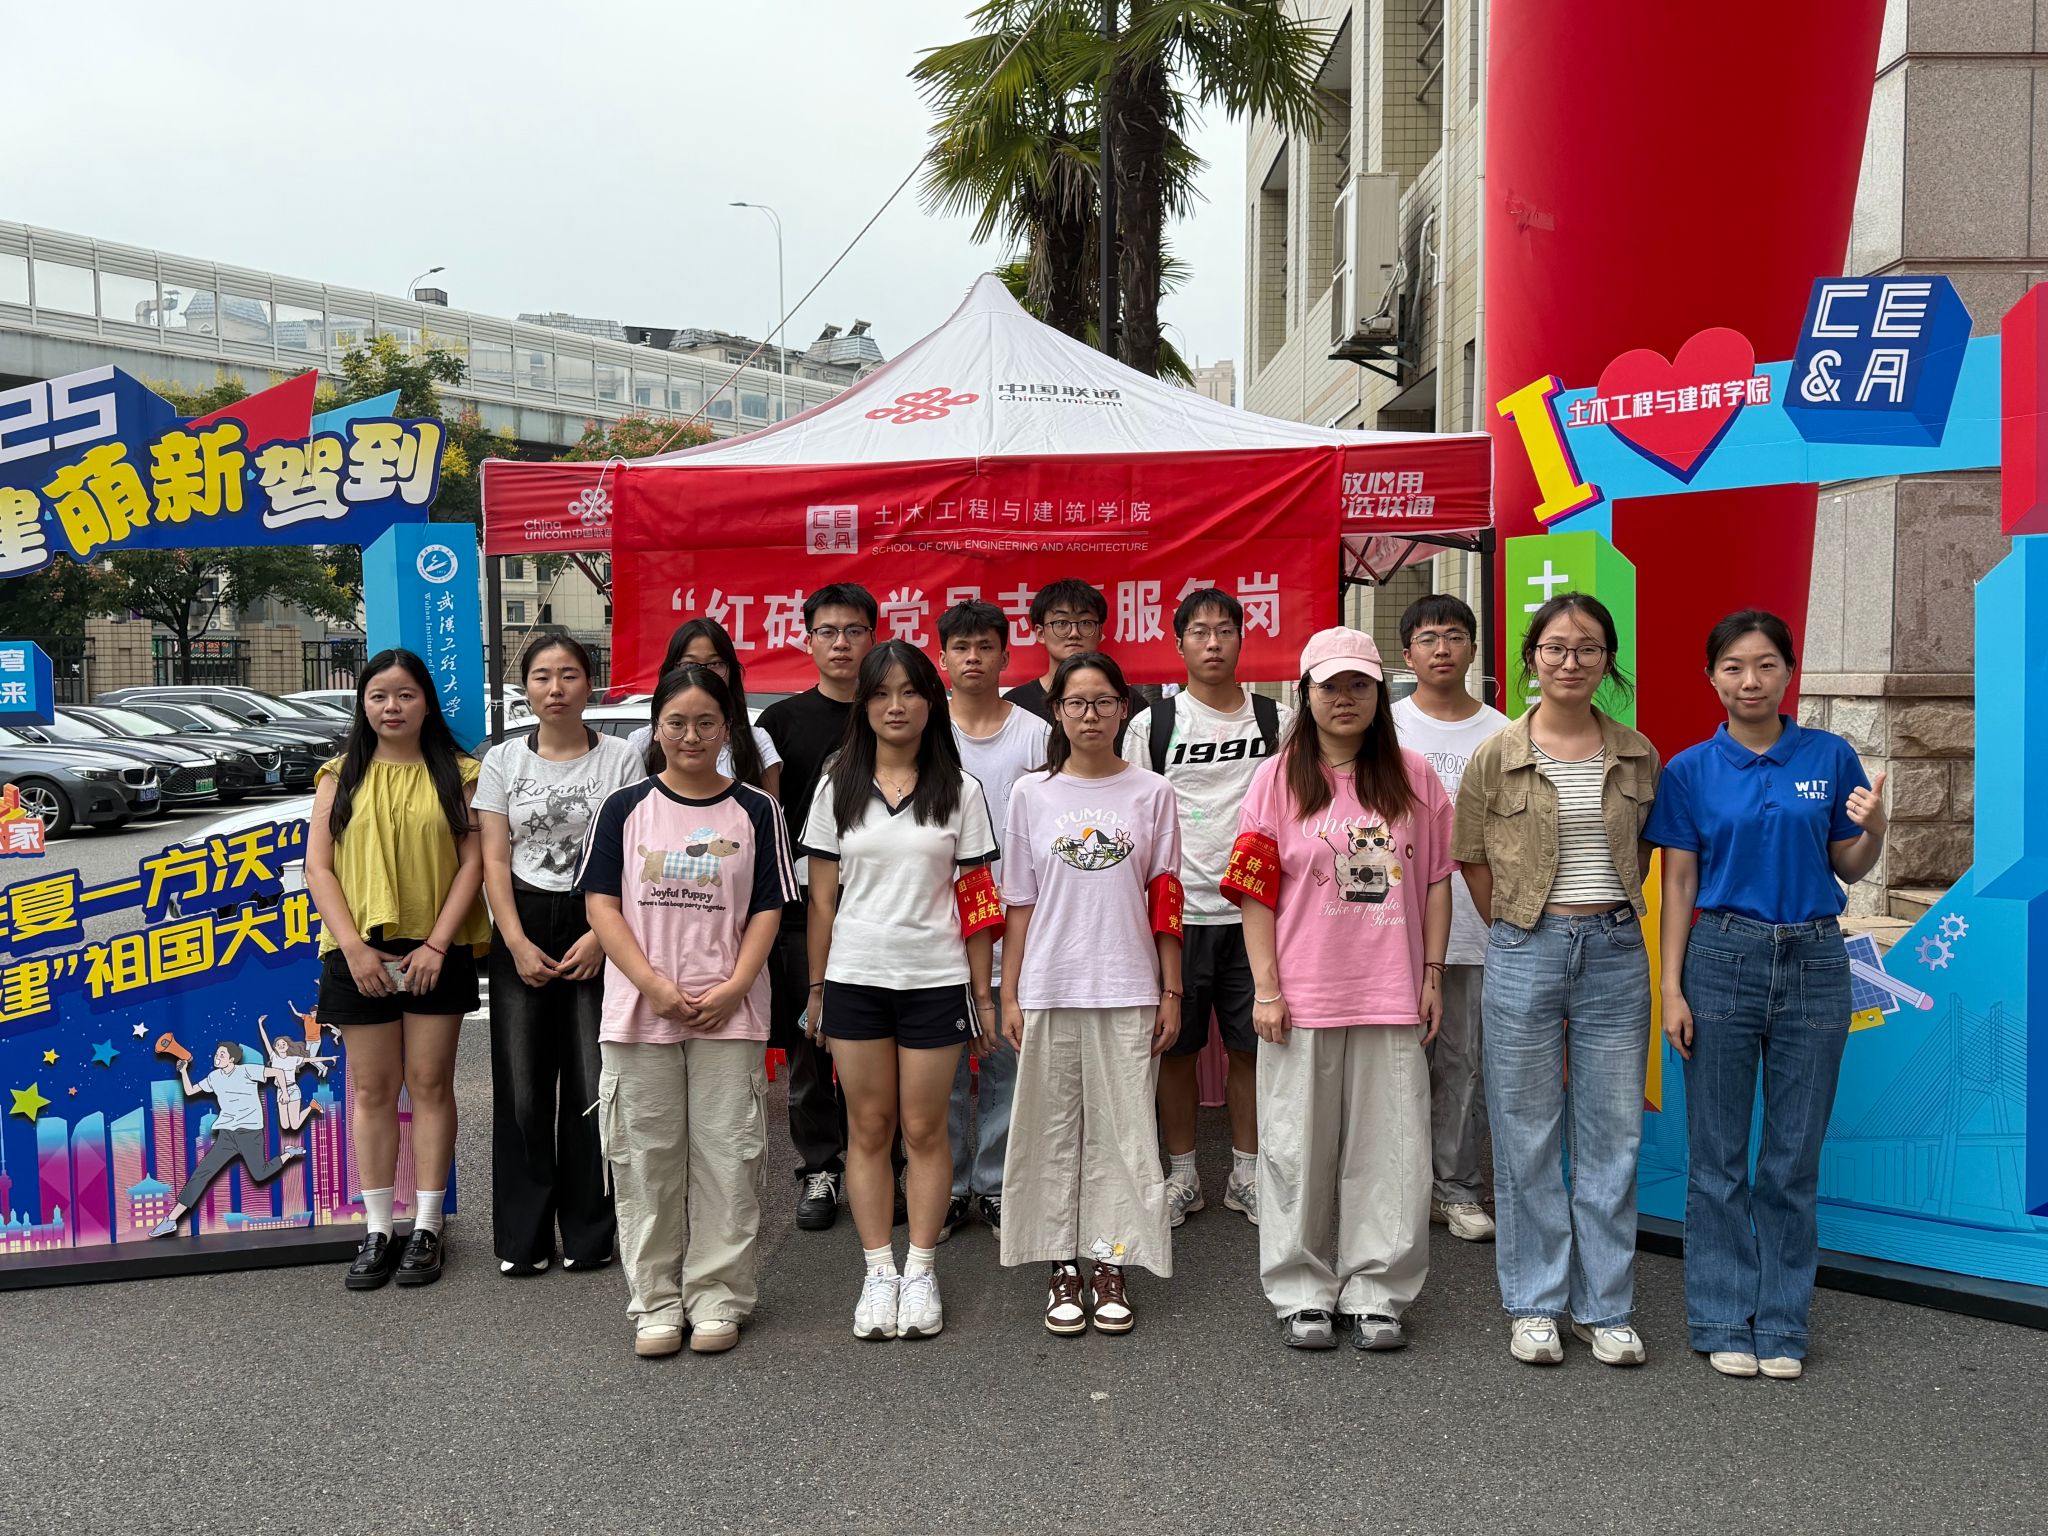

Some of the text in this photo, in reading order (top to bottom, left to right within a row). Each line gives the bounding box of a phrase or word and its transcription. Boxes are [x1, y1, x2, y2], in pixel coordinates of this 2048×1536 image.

[1811, 282, 1932, 339] CE
[998, 383, 1121, 399] 中国联通
[1055, 397, 1123, 407] unicom
[1568, 376, 1770, 426] 土木工程与建筑学院
[1496, 374, 1598, 525] I
[1342, 494, 1435, 518] 选联通
[524, 519, 561, 530] China
[813, 510, 852, 529] CE
[525, 529, 572, 540] unicom
[872, 539, 1148, 555] SCHOOL OF CIVIL ENGINEERING AND ARCHITECTURE
[424, 592, 432, 621] Wuhan
[425, 622, 433, 657] Institute
[0, 681, 27, 704] 来
[1424, 752, 1468, 774] EYON
[1794, 780, 1829, 792] WIT
[1055, 807, 1118, 829] PUMA
[0, 823, 40, 850] 家
[0, 824, 301, 942] 夏一方沃“
[651, 887, 713, 903] Joyful Puppy
[684, 902, 701, 910] party
